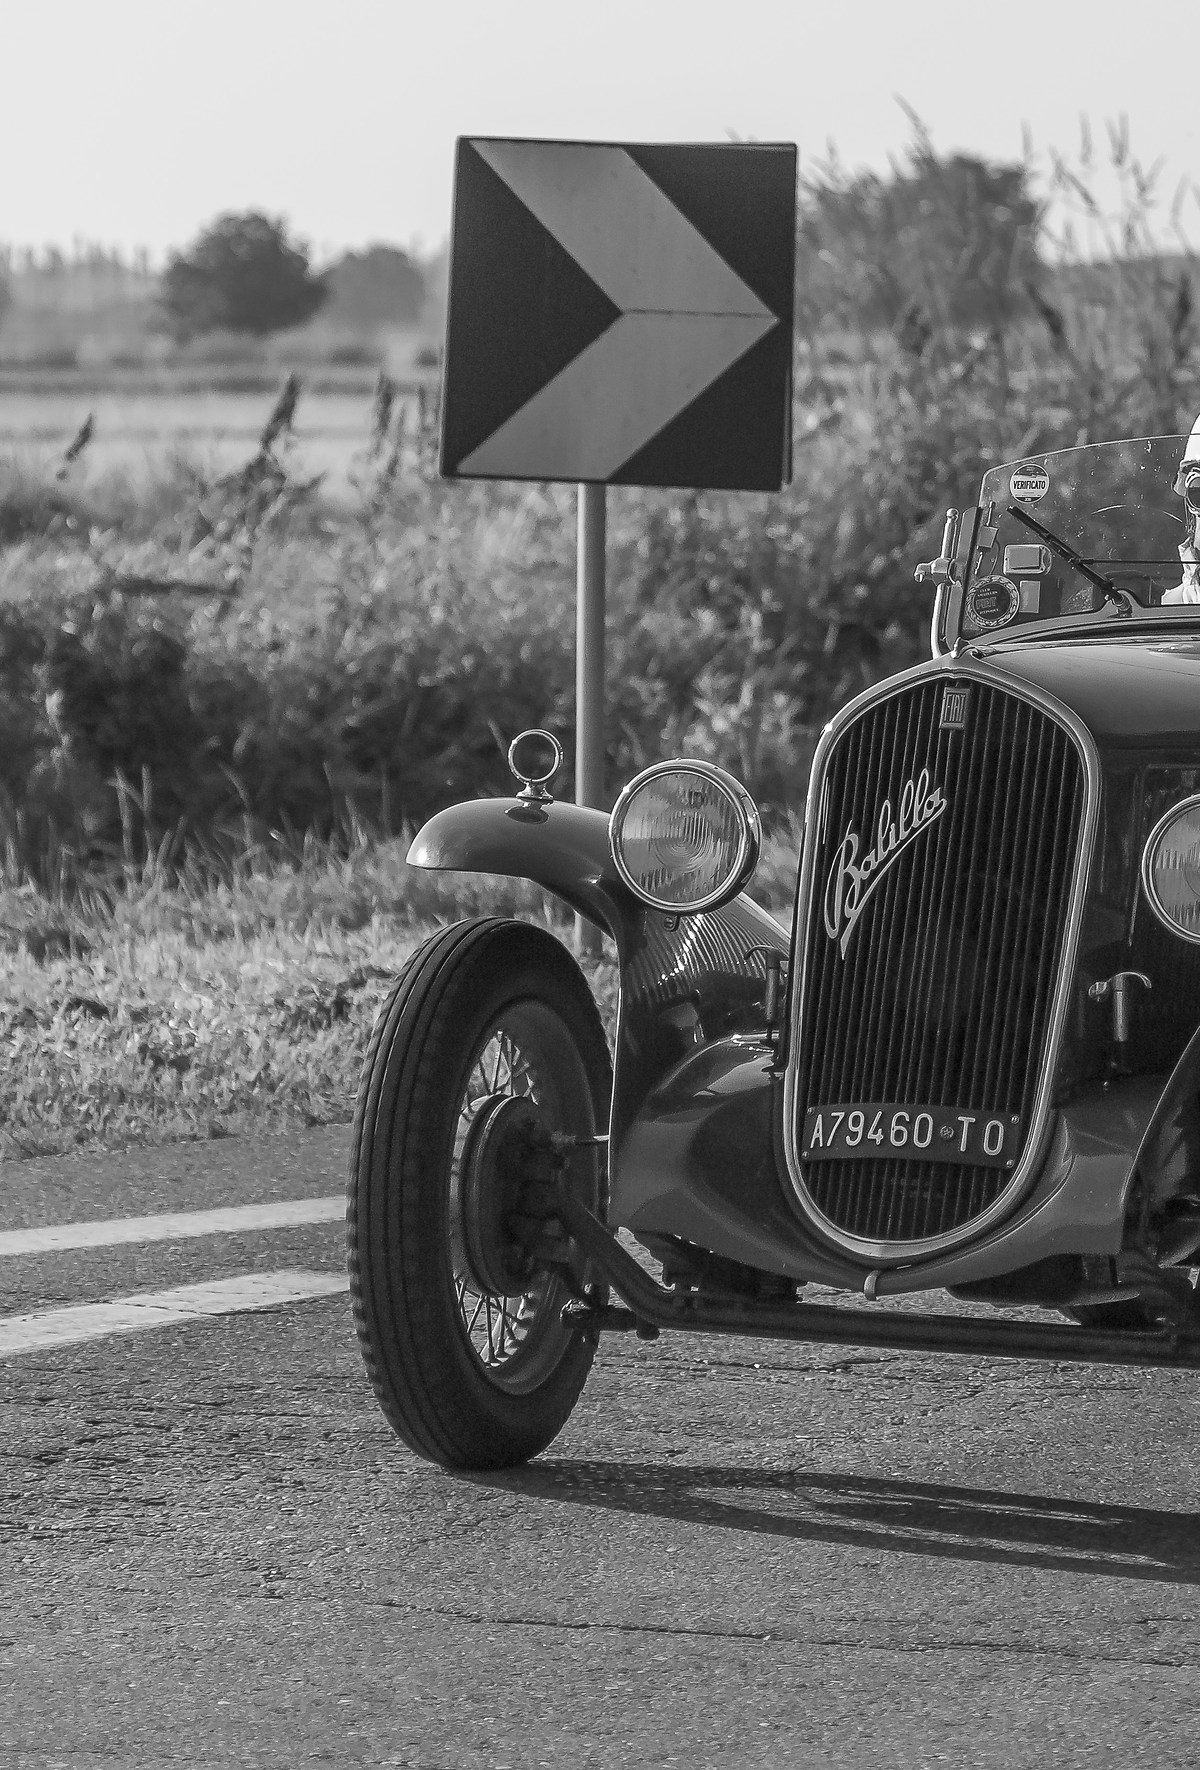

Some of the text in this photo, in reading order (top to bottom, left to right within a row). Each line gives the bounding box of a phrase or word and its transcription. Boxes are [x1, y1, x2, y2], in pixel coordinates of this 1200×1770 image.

[1013, 480, 1046, 490] VERIFICATO
[943, 693, 966, 722] FIAT
[824, 767, 948, 959] Balilla
[809, 1109, 1005, 1156] A79460 TO
